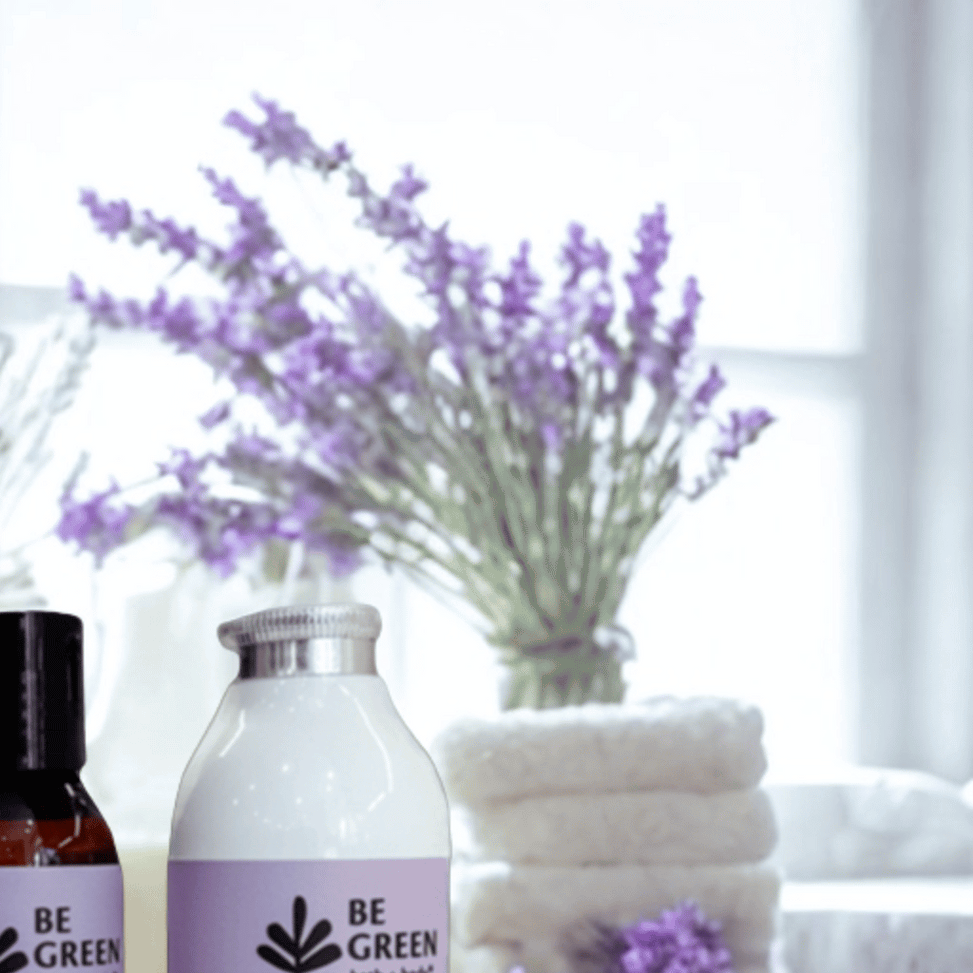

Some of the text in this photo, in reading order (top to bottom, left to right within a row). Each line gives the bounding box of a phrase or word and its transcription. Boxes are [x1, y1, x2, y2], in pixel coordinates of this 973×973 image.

[34, 906, 71, 934] BE
[348, 898, 385, 926] BE
[33, 938, 120, 969] GREEN
[347, 929, 437, 961] GREEN
